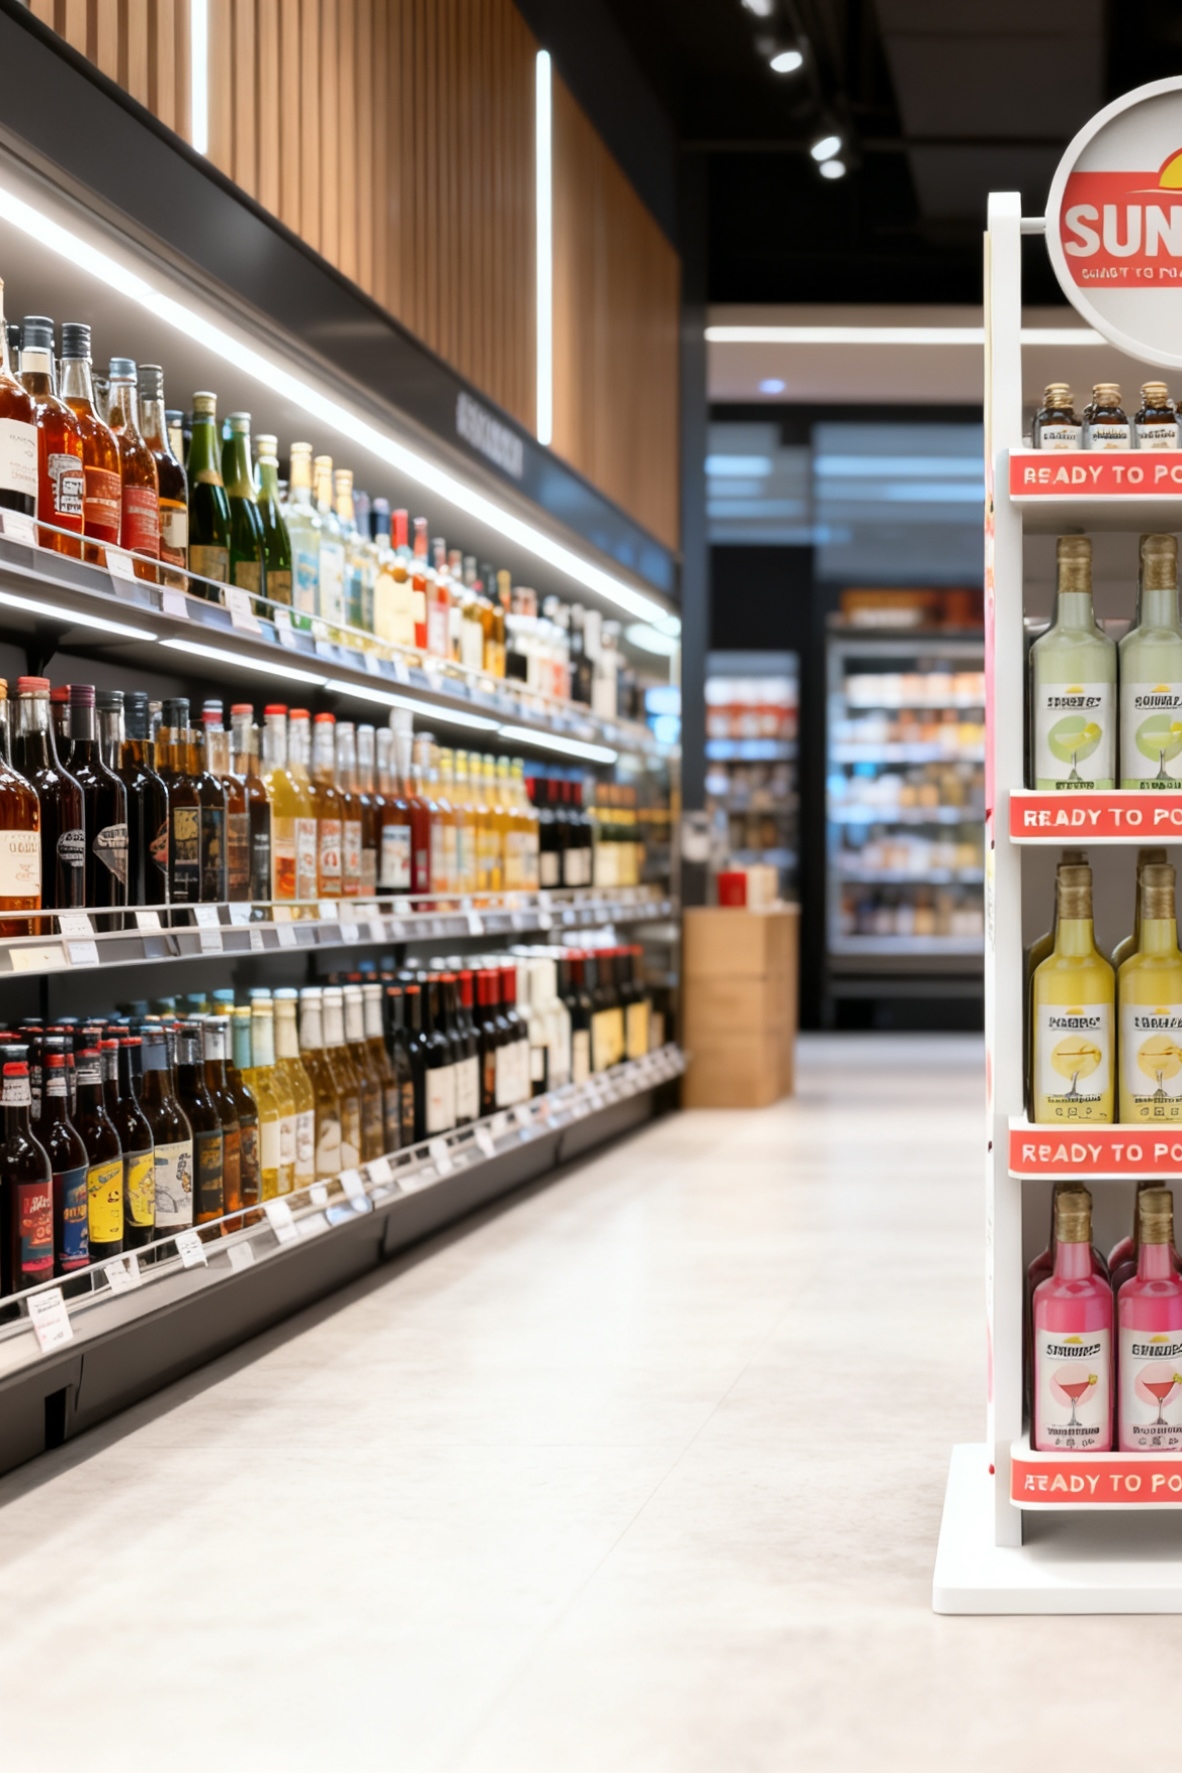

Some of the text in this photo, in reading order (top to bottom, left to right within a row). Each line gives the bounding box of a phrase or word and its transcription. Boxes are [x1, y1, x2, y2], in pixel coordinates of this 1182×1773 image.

[1024, 466, 1103, 484] READY
[1111, 466, 1144, 483] TO
[1023, 808, 1101, 826] READY
[1107, 808, 1143, 826] TO
[1110, 1143, 1143, 1161] TO
[1109, 1474, 1141, 1491] TO
